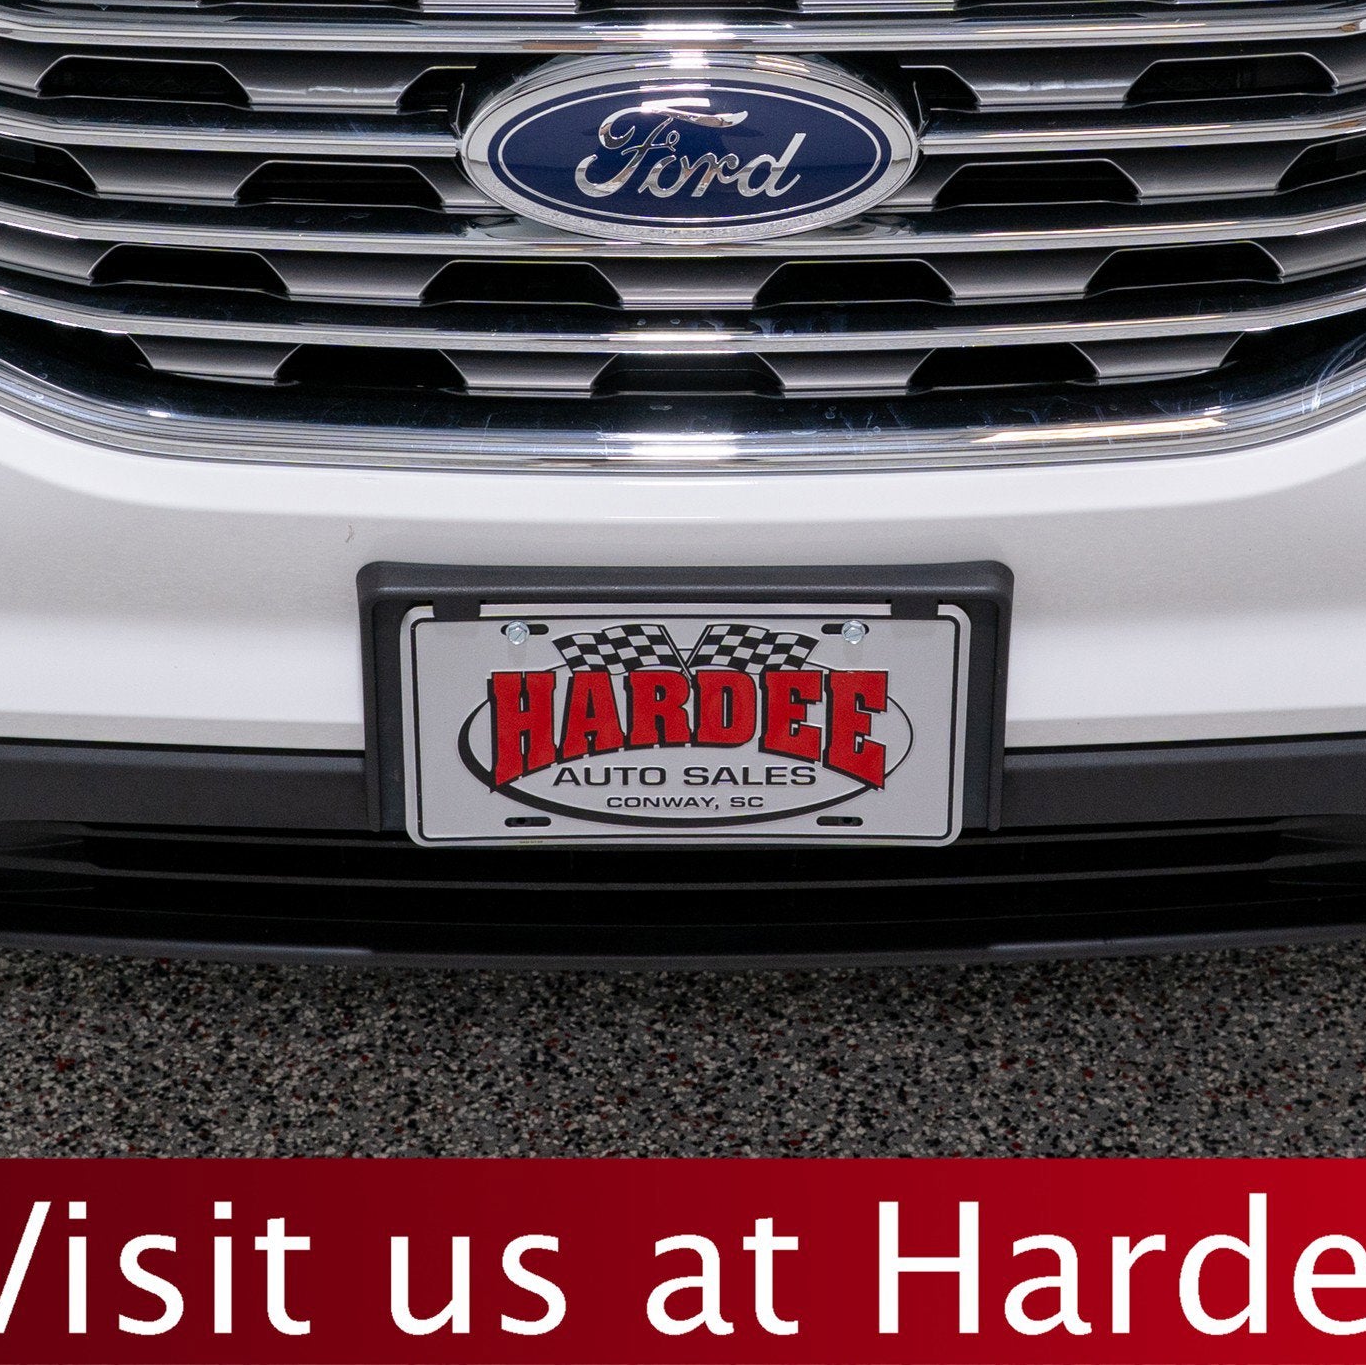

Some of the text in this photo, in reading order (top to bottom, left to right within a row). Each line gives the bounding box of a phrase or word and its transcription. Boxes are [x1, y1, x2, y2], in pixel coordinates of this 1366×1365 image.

[575, 103, 806, 198] Ford
[487, 670, 888, 791] HARDEE
[552, 765, 817, 787] AUTO SALES
[606, 795, 764, 811] CONWAY, SC
